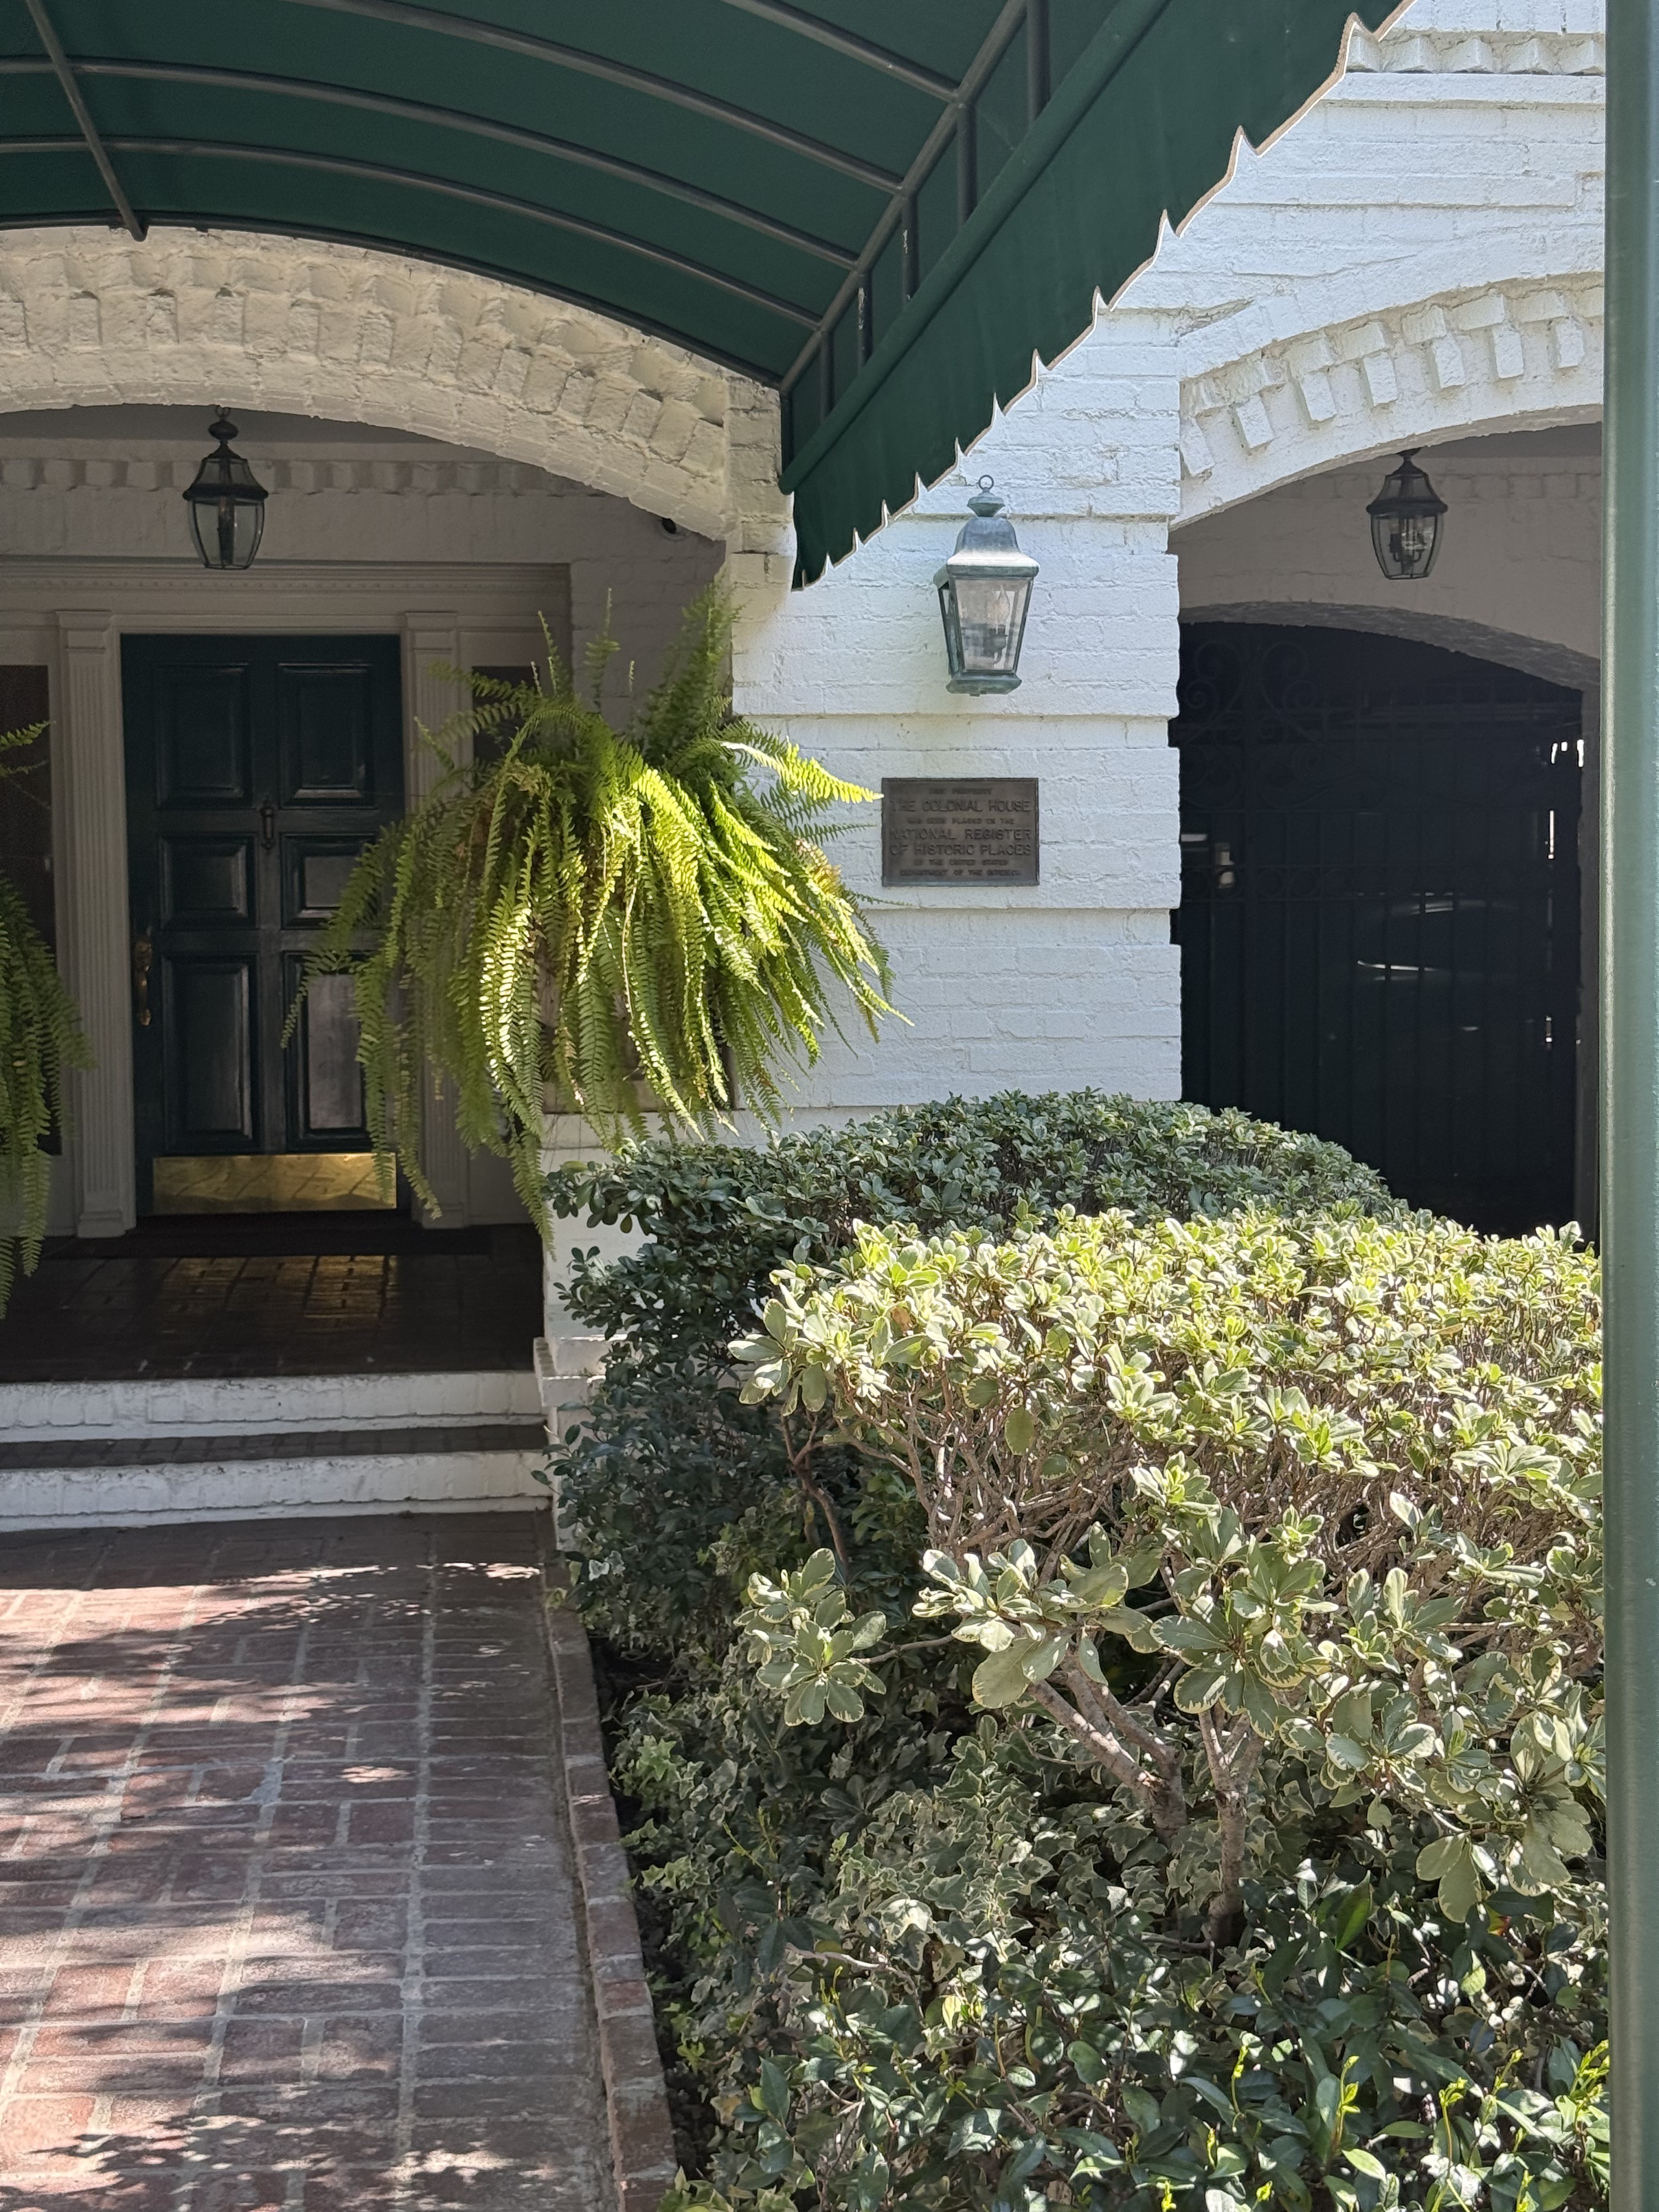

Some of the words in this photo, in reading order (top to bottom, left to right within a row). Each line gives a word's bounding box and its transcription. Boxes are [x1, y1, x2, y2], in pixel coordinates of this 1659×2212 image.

[890, 799, 916, 812] THE
[922, 799, 983, 812] COLONIAL
[989, 799, 1031, 812] HOUSE
[889, 828, 956, 840] NATIONAL
[964, 828, 1031, 840] REGISTER
[889, 844, 909, 856] OF
[914, 844, 974, 856] HISTORIC
[980, 844, 1031, 856] PLACES
